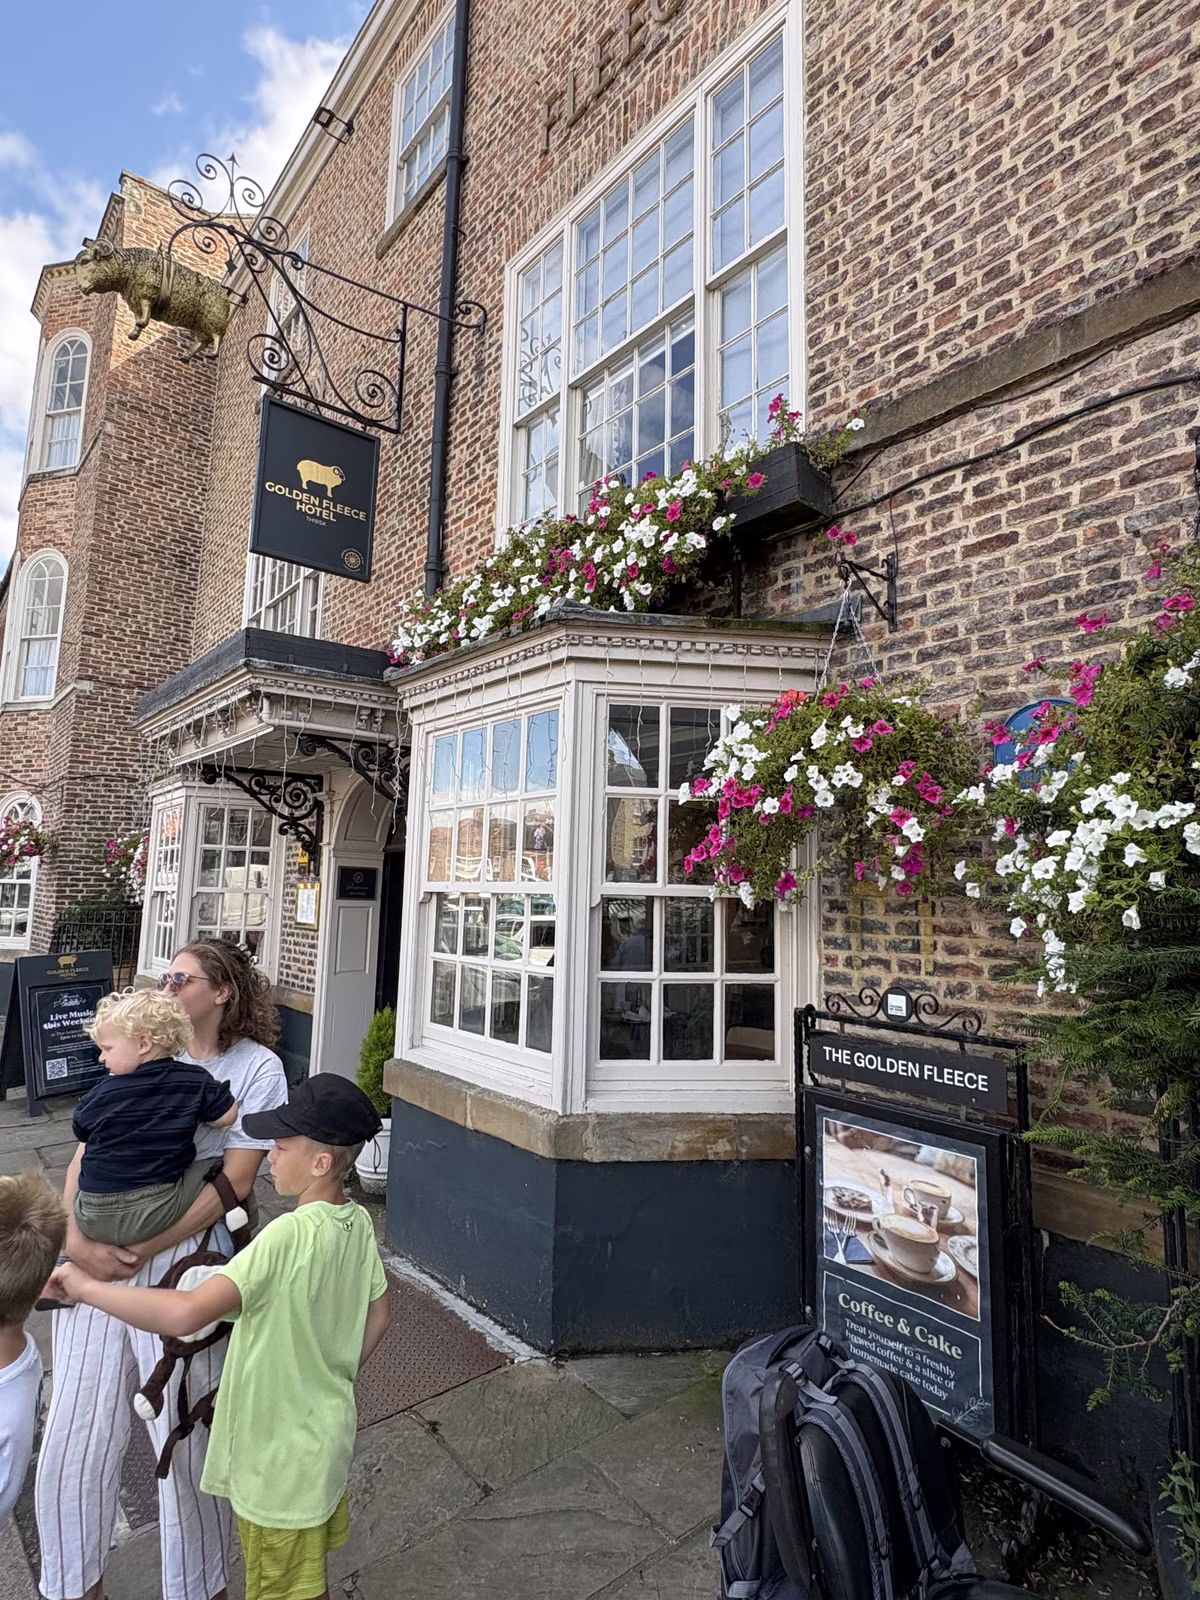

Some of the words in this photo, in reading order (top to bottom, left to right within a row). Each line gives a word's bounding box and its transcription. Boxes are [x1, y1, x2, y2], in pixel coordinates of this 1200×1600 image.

[265, 481, 320, 506] GOLDEN
[322, 499, 367, 521] FLEECE
[296, 501, 337, 522] HOTEL
[306, 515, 327, 527] THIRSK
[43, 1021, 61, 1030] this
[50, 1013, 68, 1021] Live
[69, 1009, 94, 1018] Music
[823, 1046, 851, 1065] THE
[853, 1052, 920, 1078] GOLDEN
[924, 1064, 989, 1092] FLEECE
[838, 1293, 894, 1328] Coffee
[897, 1318, 911, 1337] &
[915, 1326, 962, 1359] Cake
[845, 1318, 867, 1335] Treat
[867, 1329, 904, 1352] yourself
[904, 1345, 914, 1357] to
[922, 1355, 955, 1378] freshly
[846, 1329, 876, 1351] brewed
[877, 1345, 904, 1365] coffee
[905, 1358, 913, 1370] &
[915, 1364, 921, 1372] a
[922, 1368, 943, 1384] slice
[945, 1379, 956, 1390] of
[850, 1343, 899, 1375] homemade
[900, 1370, 921, 1386] cake
[922, 1378, 948, 1400] today
